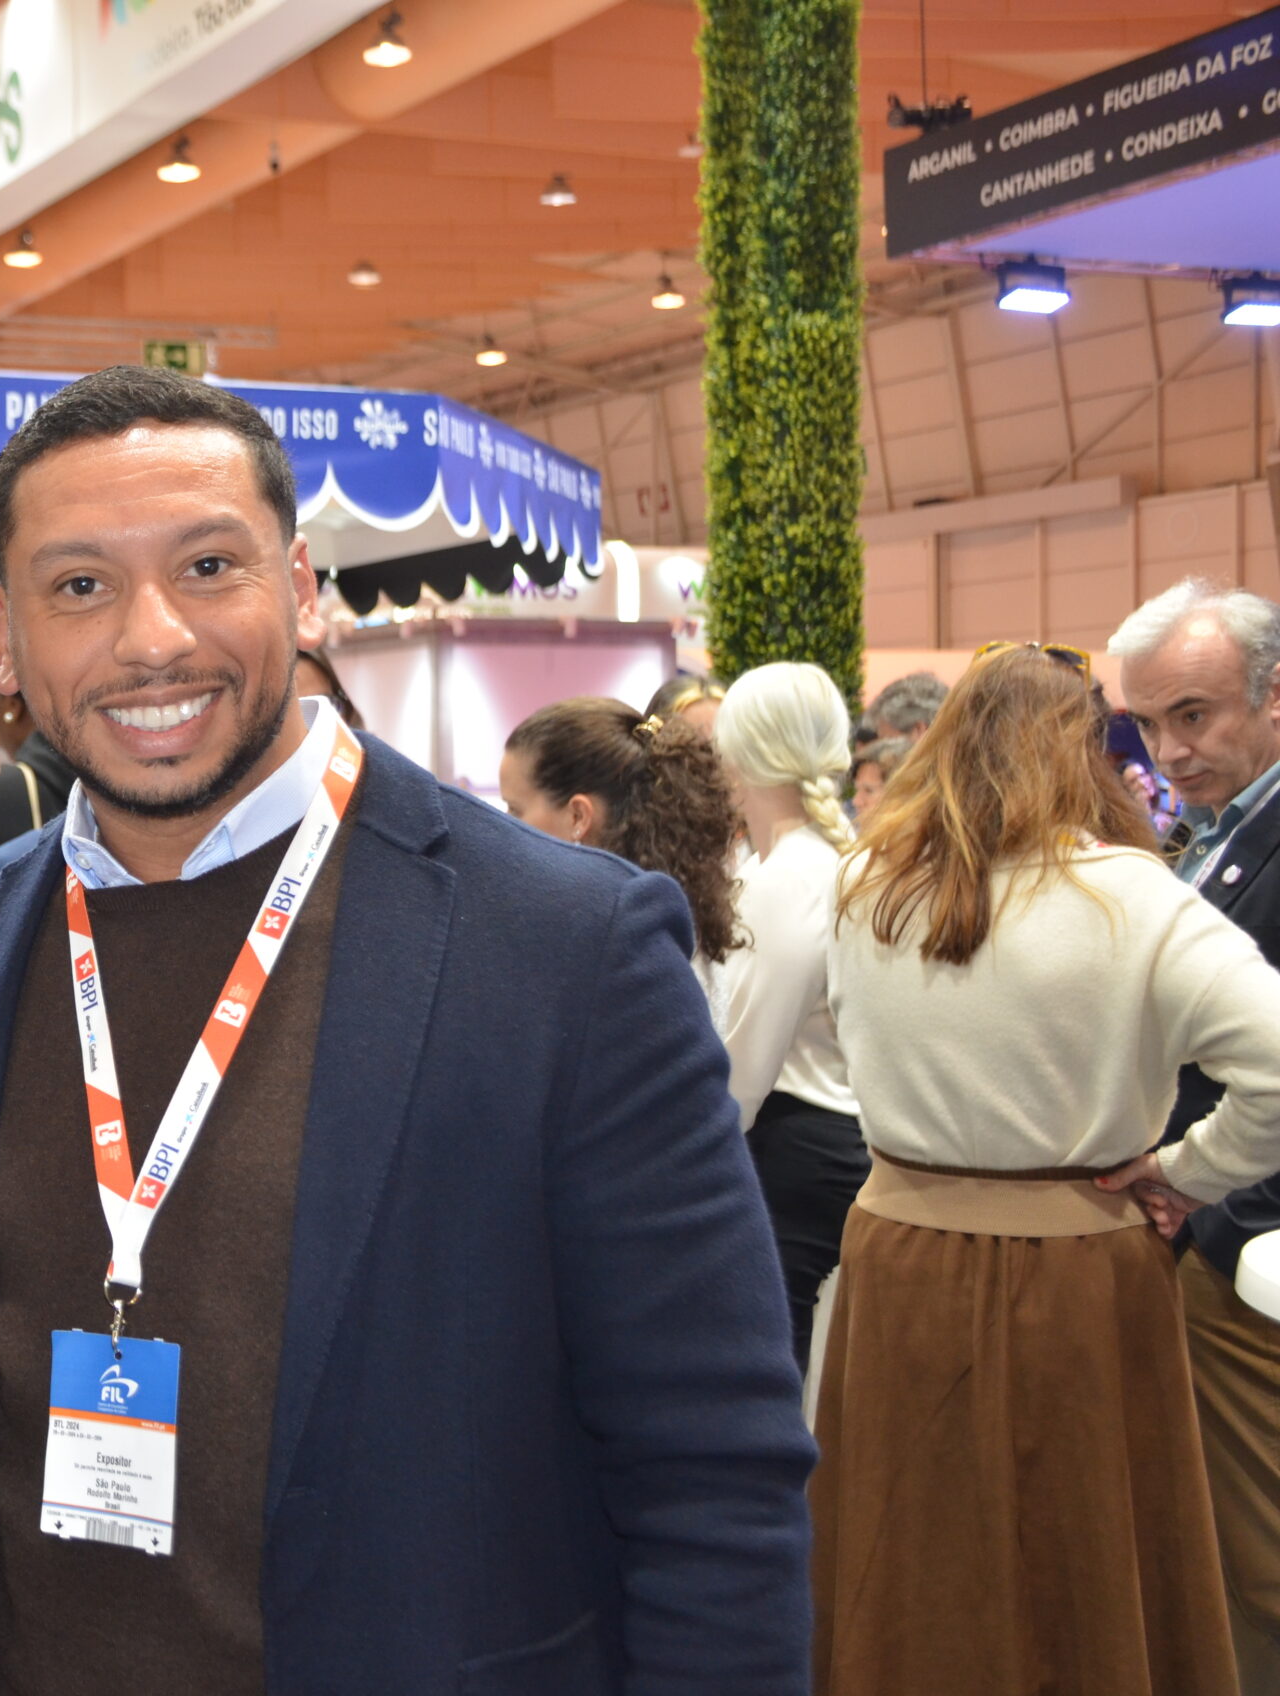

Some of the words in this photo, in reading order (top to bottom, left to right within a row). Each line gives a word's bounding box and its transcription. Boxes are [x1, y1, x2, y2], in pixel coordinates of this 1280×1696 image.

[907, 141, 977, 183] ARGANIL
[999, 105, 1080, 151] COIMBRA
[1102, 63, 1192, 116] FIGUEIRA
[1195, 51, 1227, 83] DA
[1231, 33, 1273, 71] FOZ
[980, 150, 1095, 207] CANTANHEDE
[1122, 107, 1223, 161] CONDEIXA
[292, 408, 339, 441] ISSO
[271, 876, 302, 913] BPI
[79, 975, 99, 1012] BPI
[148, 1142, 180, 1181] BPI
[101, 1386, 125, 1404] FIL
[66, 1421, 80, 1431] 2024
[96, 1452, 132, 1468] Expositor
[86, 1488, 111, 1500] Rodolfo
[95, 1478, 109, 1489] São
[111, 1480, 131, 1493] Paulo
